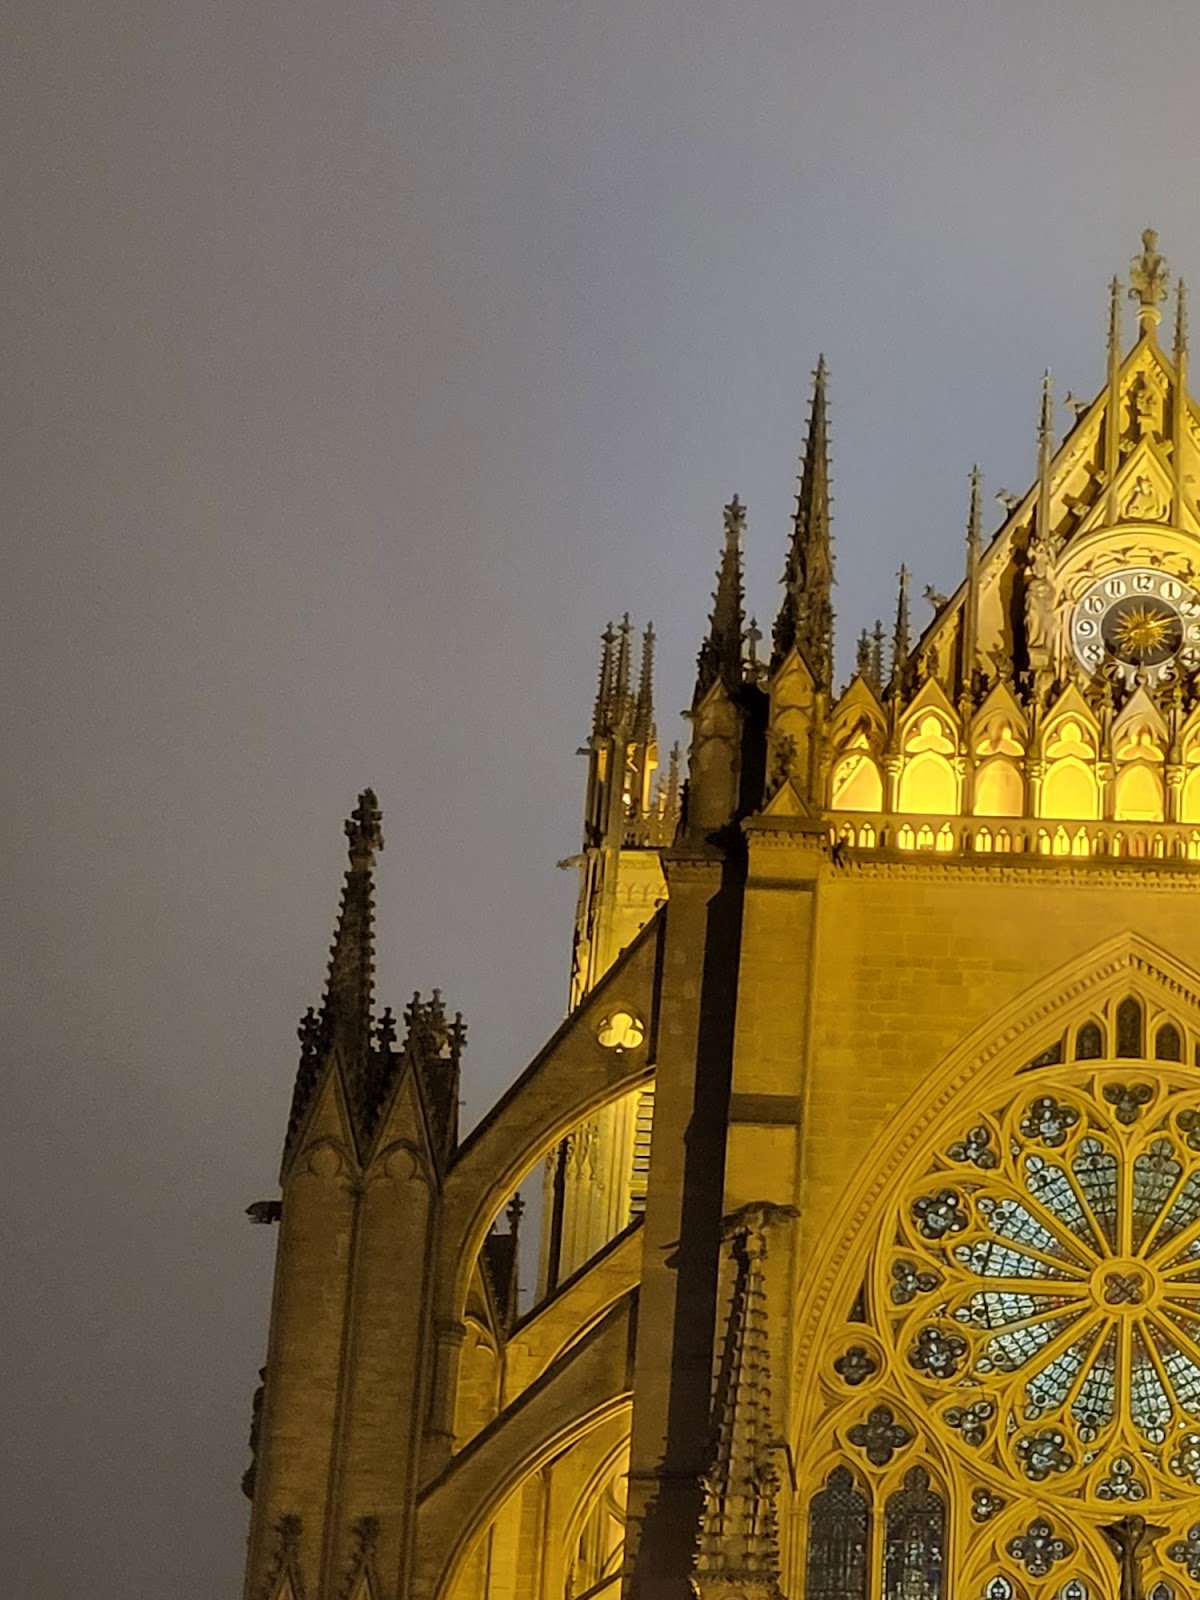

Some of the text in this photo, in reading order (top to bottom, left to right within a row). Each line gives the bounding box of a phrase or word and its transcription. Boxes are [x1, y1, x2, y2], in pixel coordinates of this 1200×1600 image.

[1110, 580, 1121, 595] 11
[1136, 576, 1152, 590] 12
[1087, 596, 1104, 613] 10
[1079, 620, 1094, 637] 9
[1086, 645, 1101, 661] 8
[1180, 649, 1197, 665] 4
[1104, 663, 1119, 679] 7
[1162, 665, 1176, 681] 5
